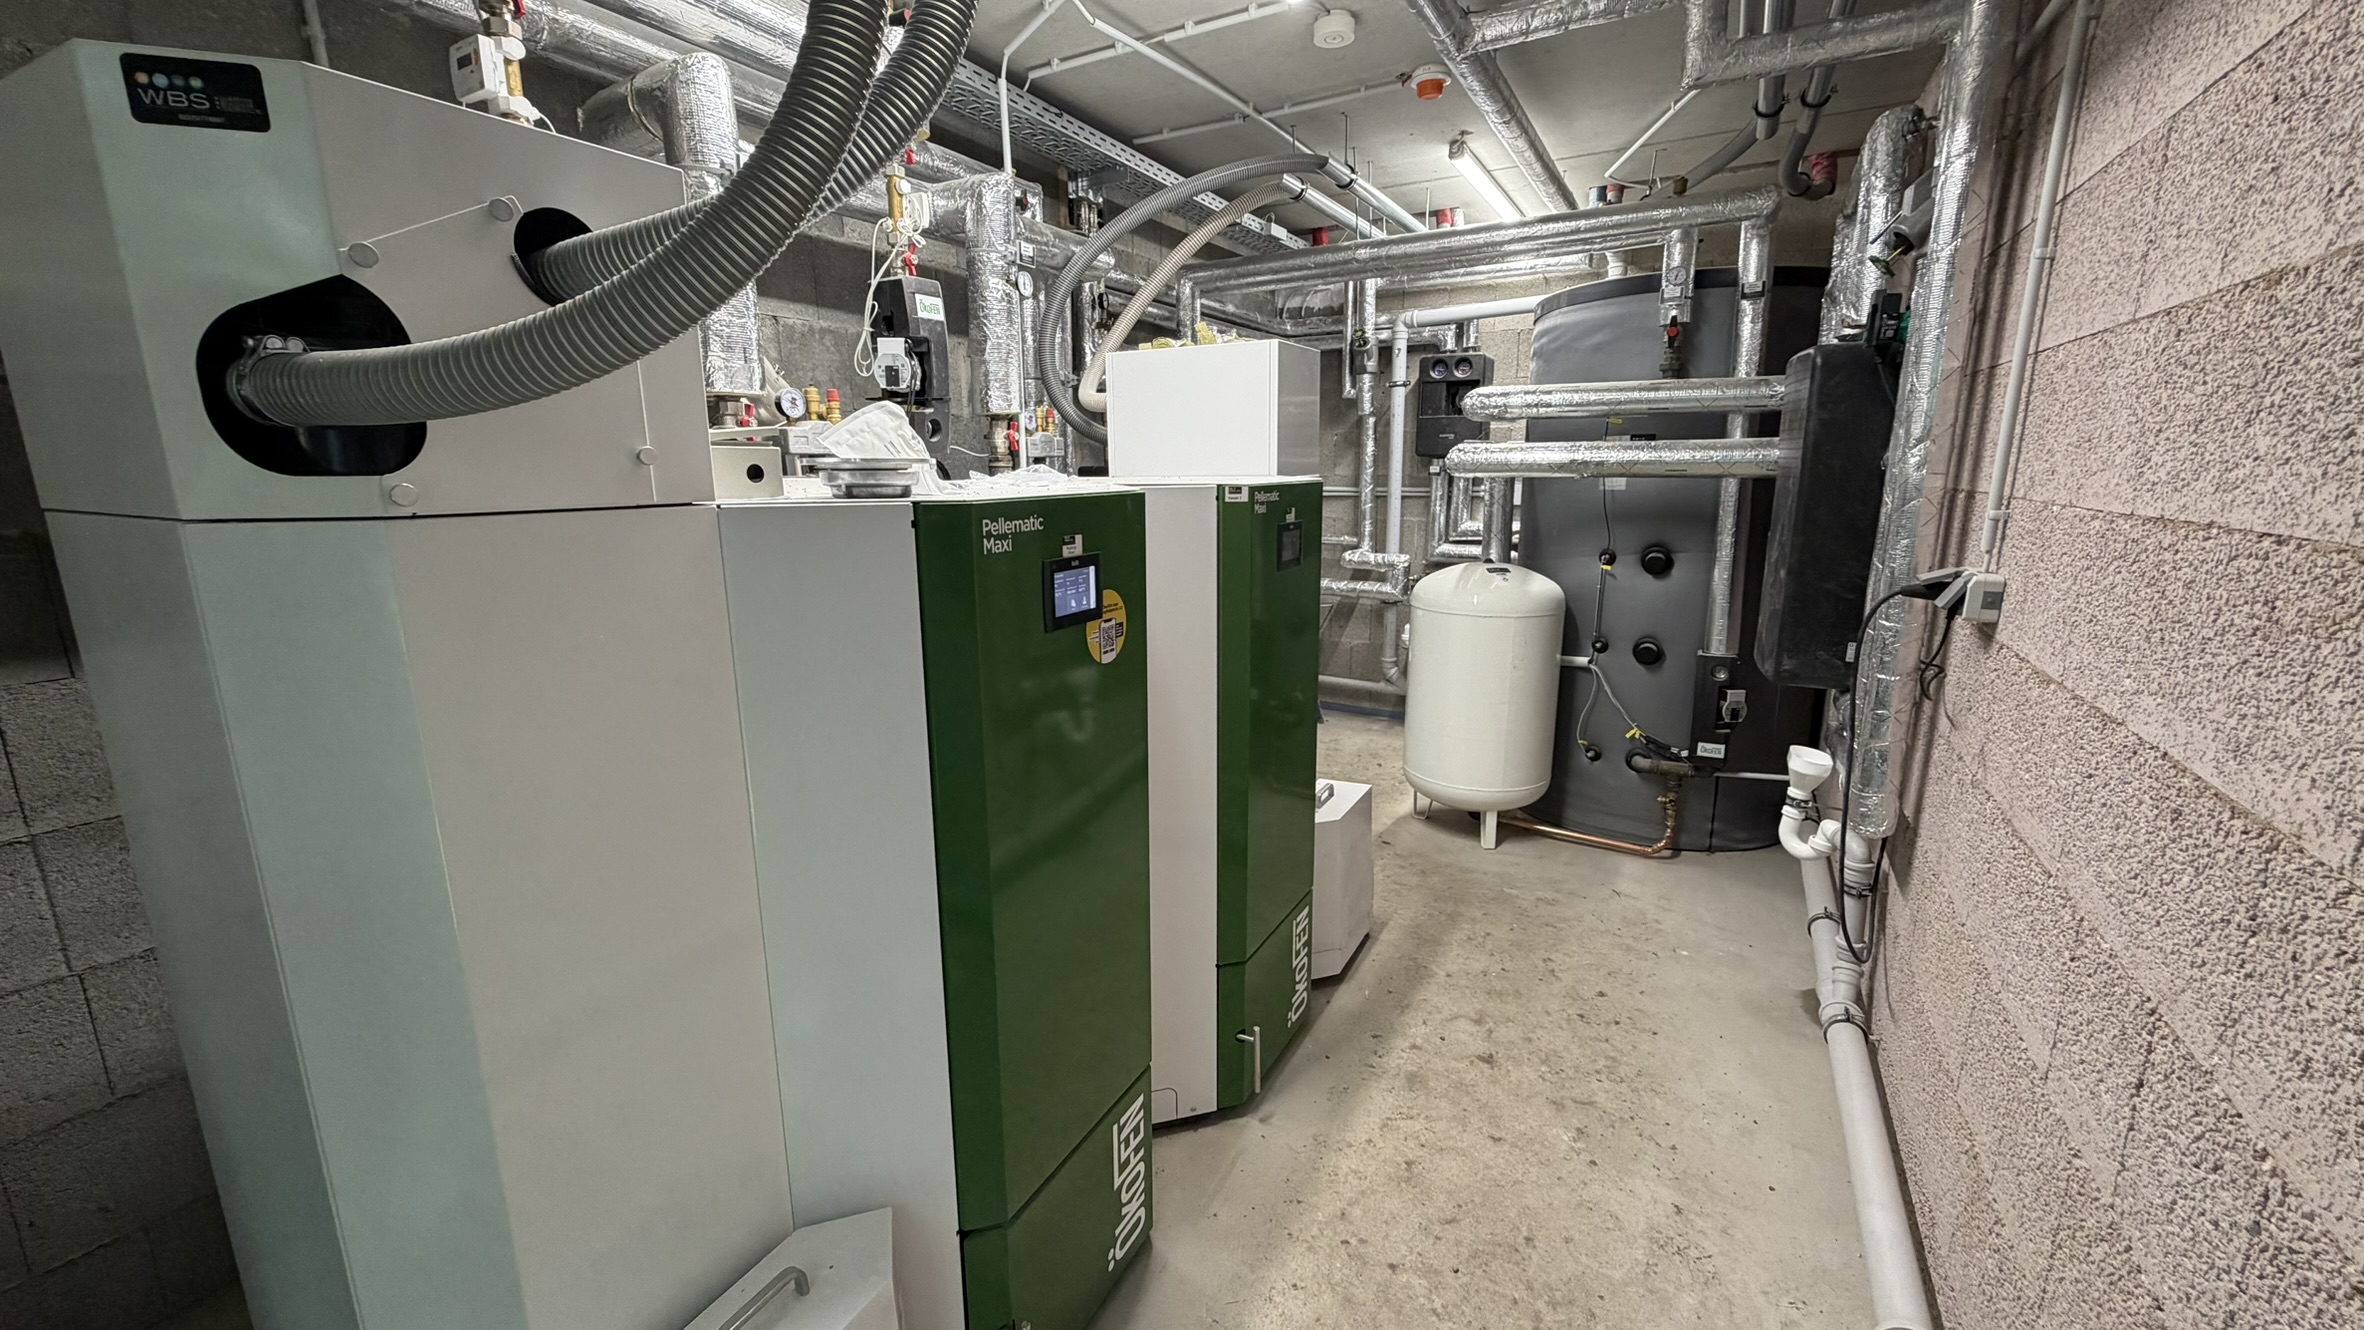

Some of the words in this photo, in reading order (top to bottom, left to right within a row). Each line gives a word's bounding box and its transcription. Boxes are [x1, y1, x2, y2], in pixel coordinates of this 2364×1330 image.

[136, 87, 210, 109] WBS
[982, 515, 1044, 536] Pellematic
[983, 535, 1013, 555] Maxi
